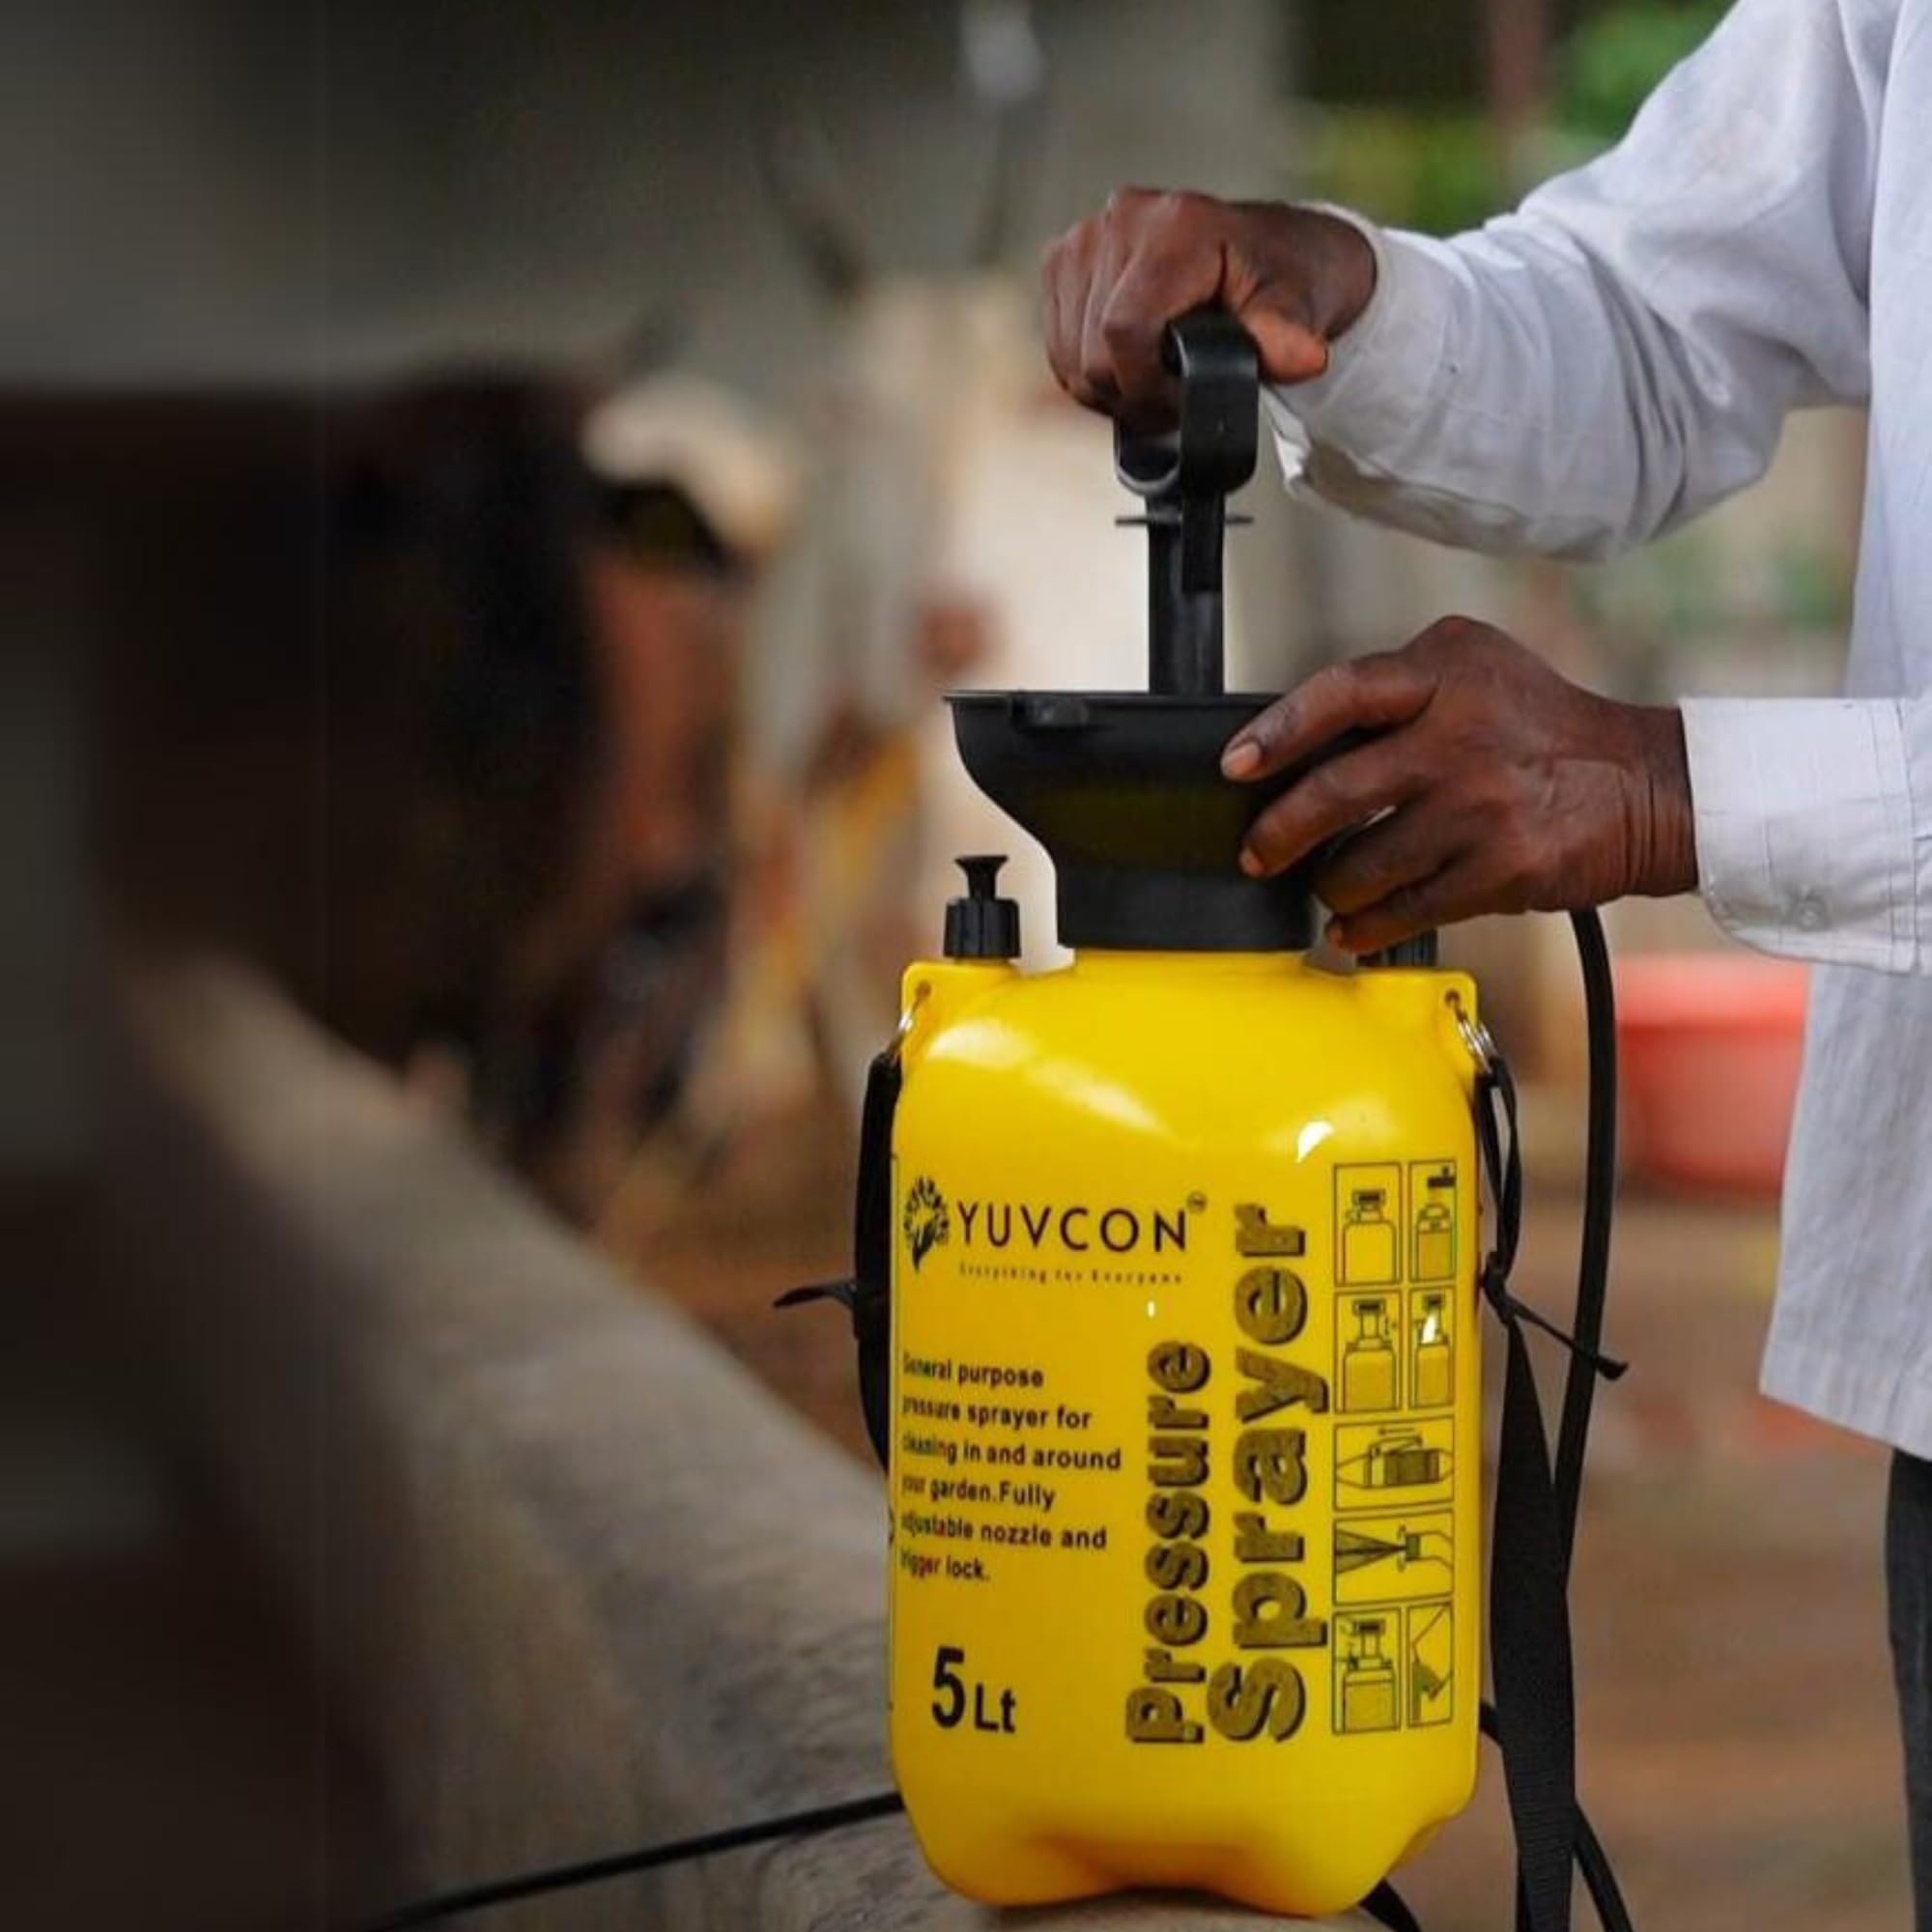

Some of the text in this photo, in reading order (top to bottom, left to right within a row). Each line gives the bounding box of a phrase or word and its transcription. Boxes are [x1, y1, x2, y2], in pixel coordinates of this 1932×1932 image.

[956, 1201, 1186, 1253] YUVCON
[957, 1362, 1043, 1389] purpose
[967, 1404, 1049, 1431] sprayer
[1057, 1406, 1092, 1429] for
[963, 1439, 981, 1463] in
[986, 1445, 1026, 1466] and
[1032, 1448, 1122, 1471] around
[1207, 1203, 1329, 1743] Sprayer
[981, 1525, 1052, 1548] nozzle
[1061, 1527, 1107, 1549] and
[1125, 1341, 1211, 1744] Pressure
[931, 1645, 1016, 1734] 5 Lt
